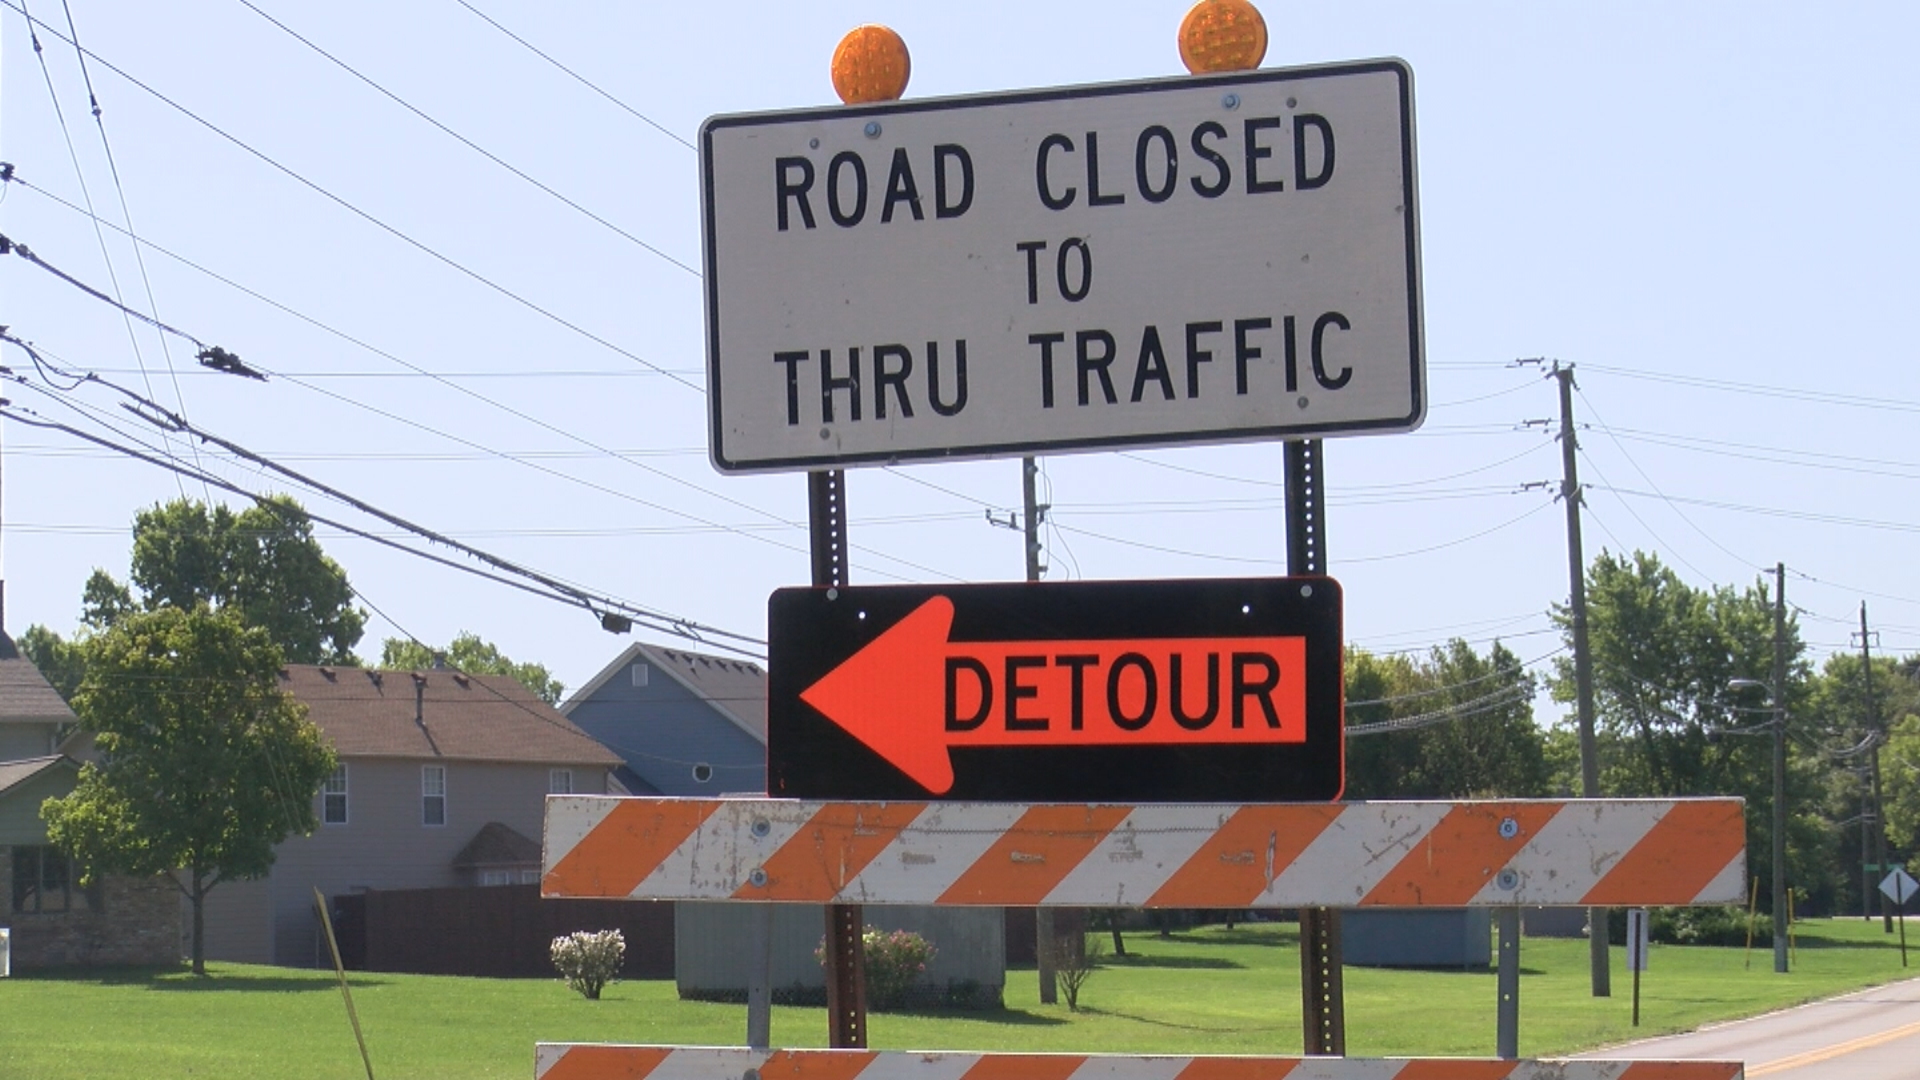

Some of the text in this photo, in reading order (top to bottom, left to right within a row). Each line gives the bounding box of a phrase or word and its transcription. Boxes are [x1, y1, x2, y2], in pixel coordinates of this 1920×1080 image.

[776, 112, 1336, 233] ROAD CLOSED
[1016, 236, 1093, 305] TO
[774, 311, 1353, 426] THRU TRAFFIC
[944, 651, 1282, 732] DETOUR
